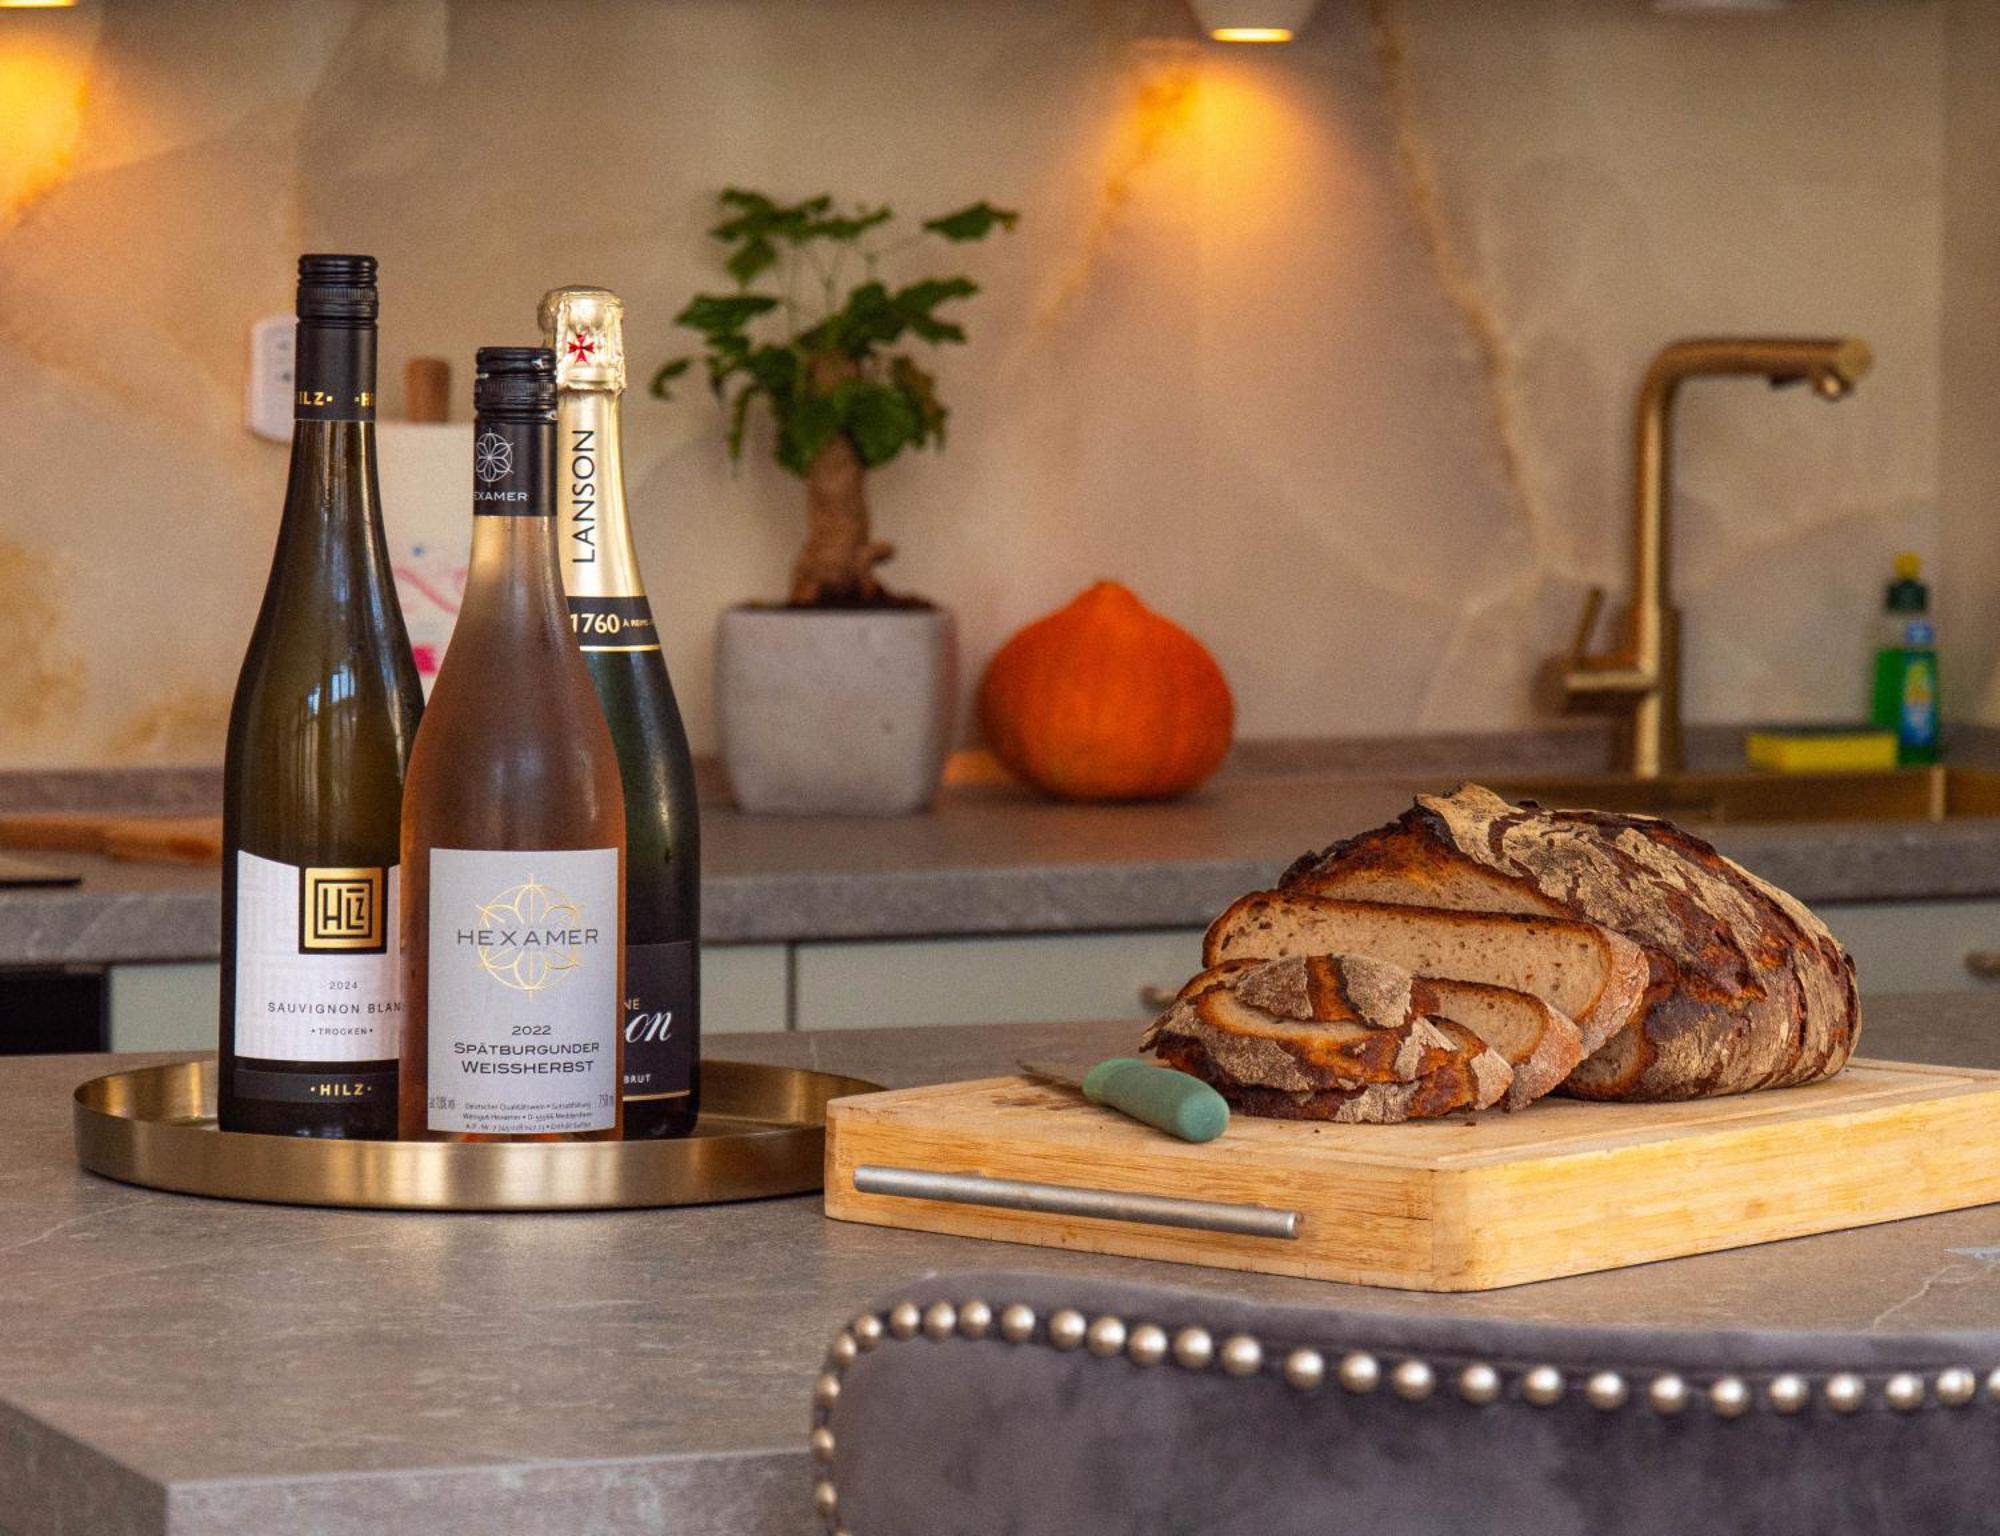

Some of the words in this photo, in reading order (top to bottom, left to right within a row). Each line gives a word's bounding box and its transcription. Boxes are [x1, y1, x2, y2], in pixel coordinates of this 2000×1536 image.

[571, 430, 596, 563] LANSON
[570, 613, 620, 634] 1760
[457, 928, 599, 946] HEXAMER
[328, 981, 359, 991] 2024
[267, 1002, 360, 1014] SAUVIGNON
[318, 1027, 367, 1036] TROCKEN
[511, 1025, 552, 1036] 2022
[454, 1042, 600, 1056] SPÄTBURGUNDER
[461, 1060, 595, 1075] WEISSHERBST
[623, 1073, 652, 1085] BRUT
[320, 1083, 364, 1097] HILZ
